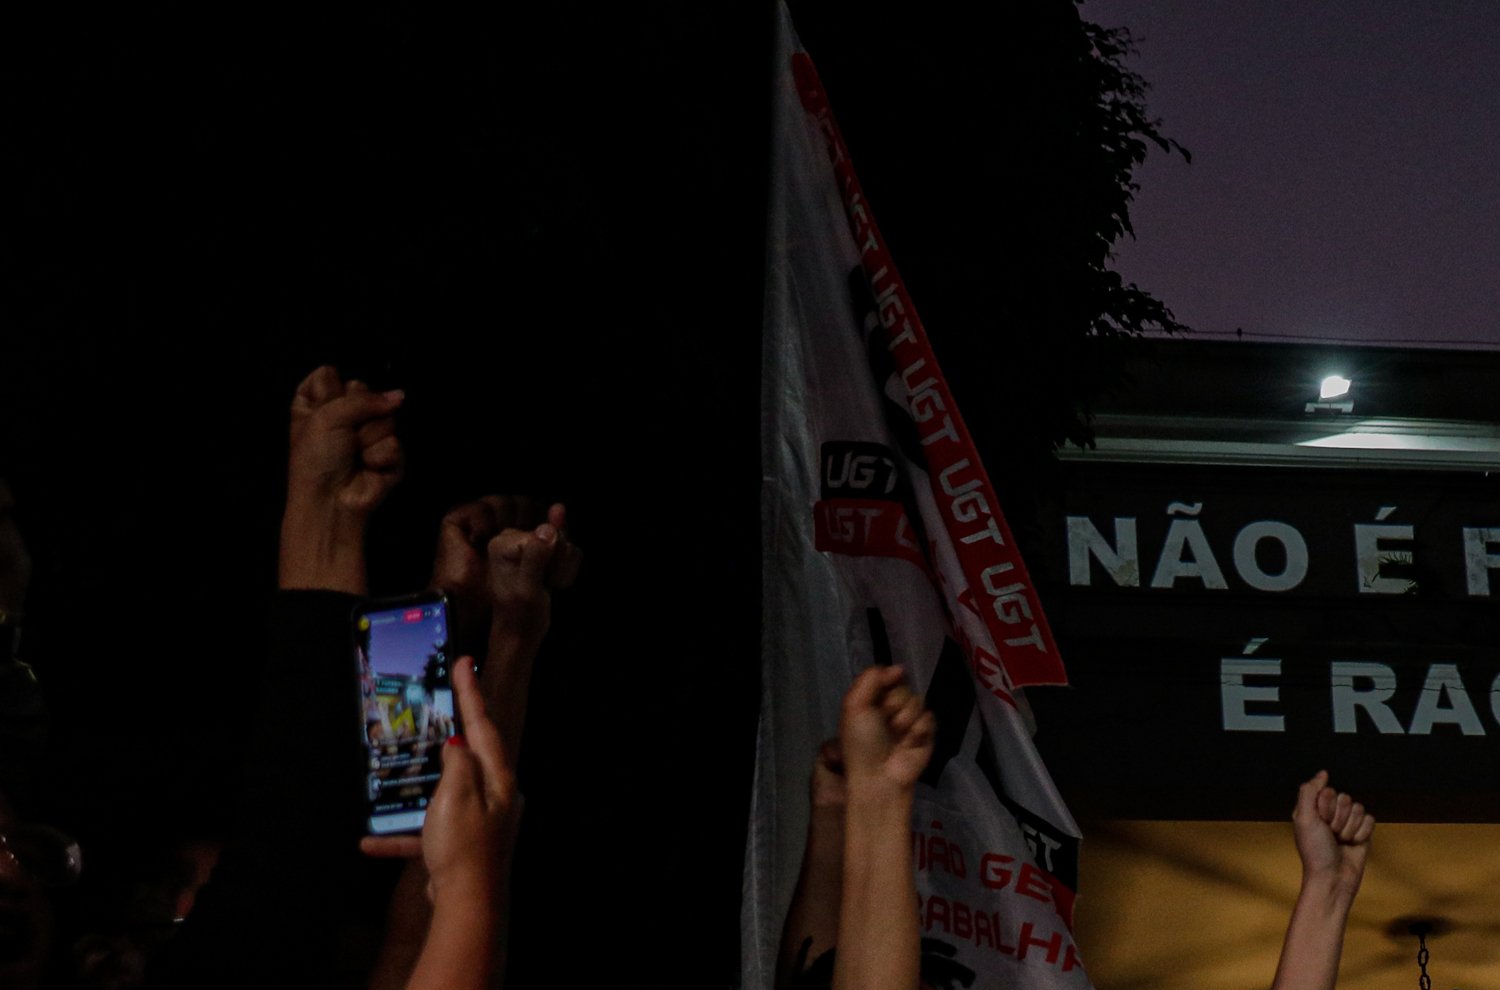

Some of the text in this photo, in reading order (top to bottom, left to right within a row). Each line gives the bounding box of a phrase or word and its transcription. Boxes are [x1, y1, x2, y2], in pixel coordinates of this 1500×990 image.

[870, 265, 918, 352] UGT
[899, 358, 960, 448] UGT
[938, 457, 1005, 549] UGT
[1065, 501, 1310, 594] NÃO
[1353, 505, 1415, 595] É
[980, 561, 1048, 654] UGT
[1219, 637, 1286, 733] É
